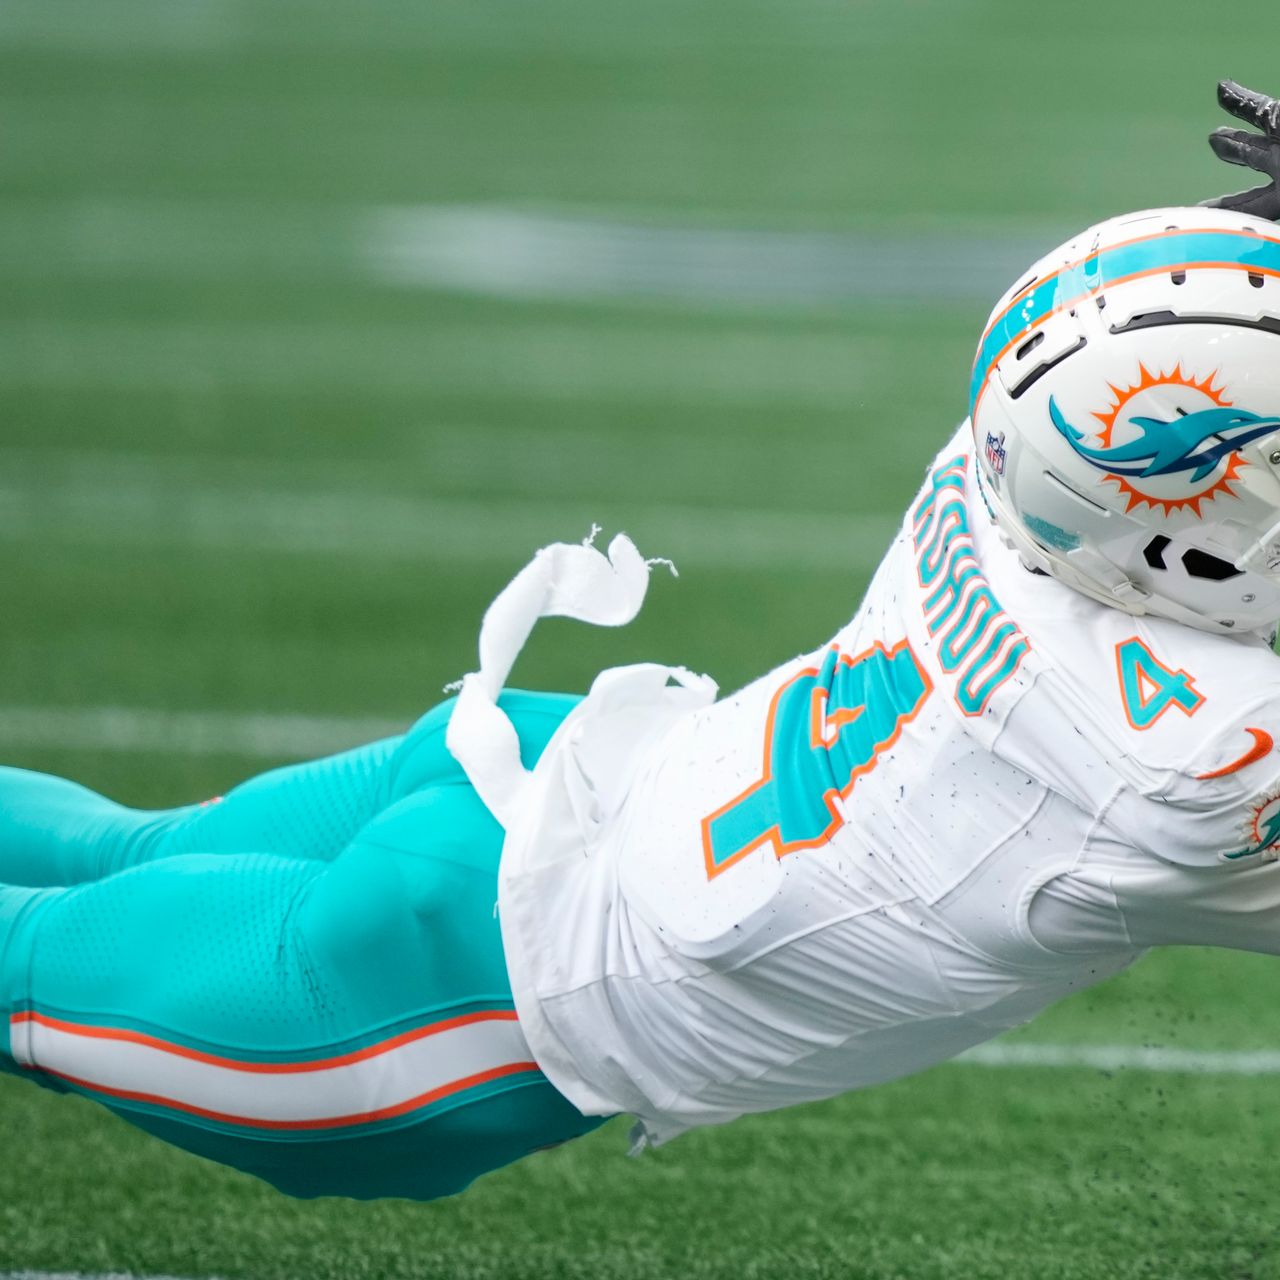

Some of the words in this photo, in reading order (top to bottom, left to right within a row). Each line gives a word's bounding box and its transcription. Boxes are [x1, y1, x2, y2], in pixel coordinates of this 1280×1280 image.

[913, 453, 1032, 717] KOHOU
[1114, 635, 1208, 731] 4
[701, 636, 935, 882] 4
